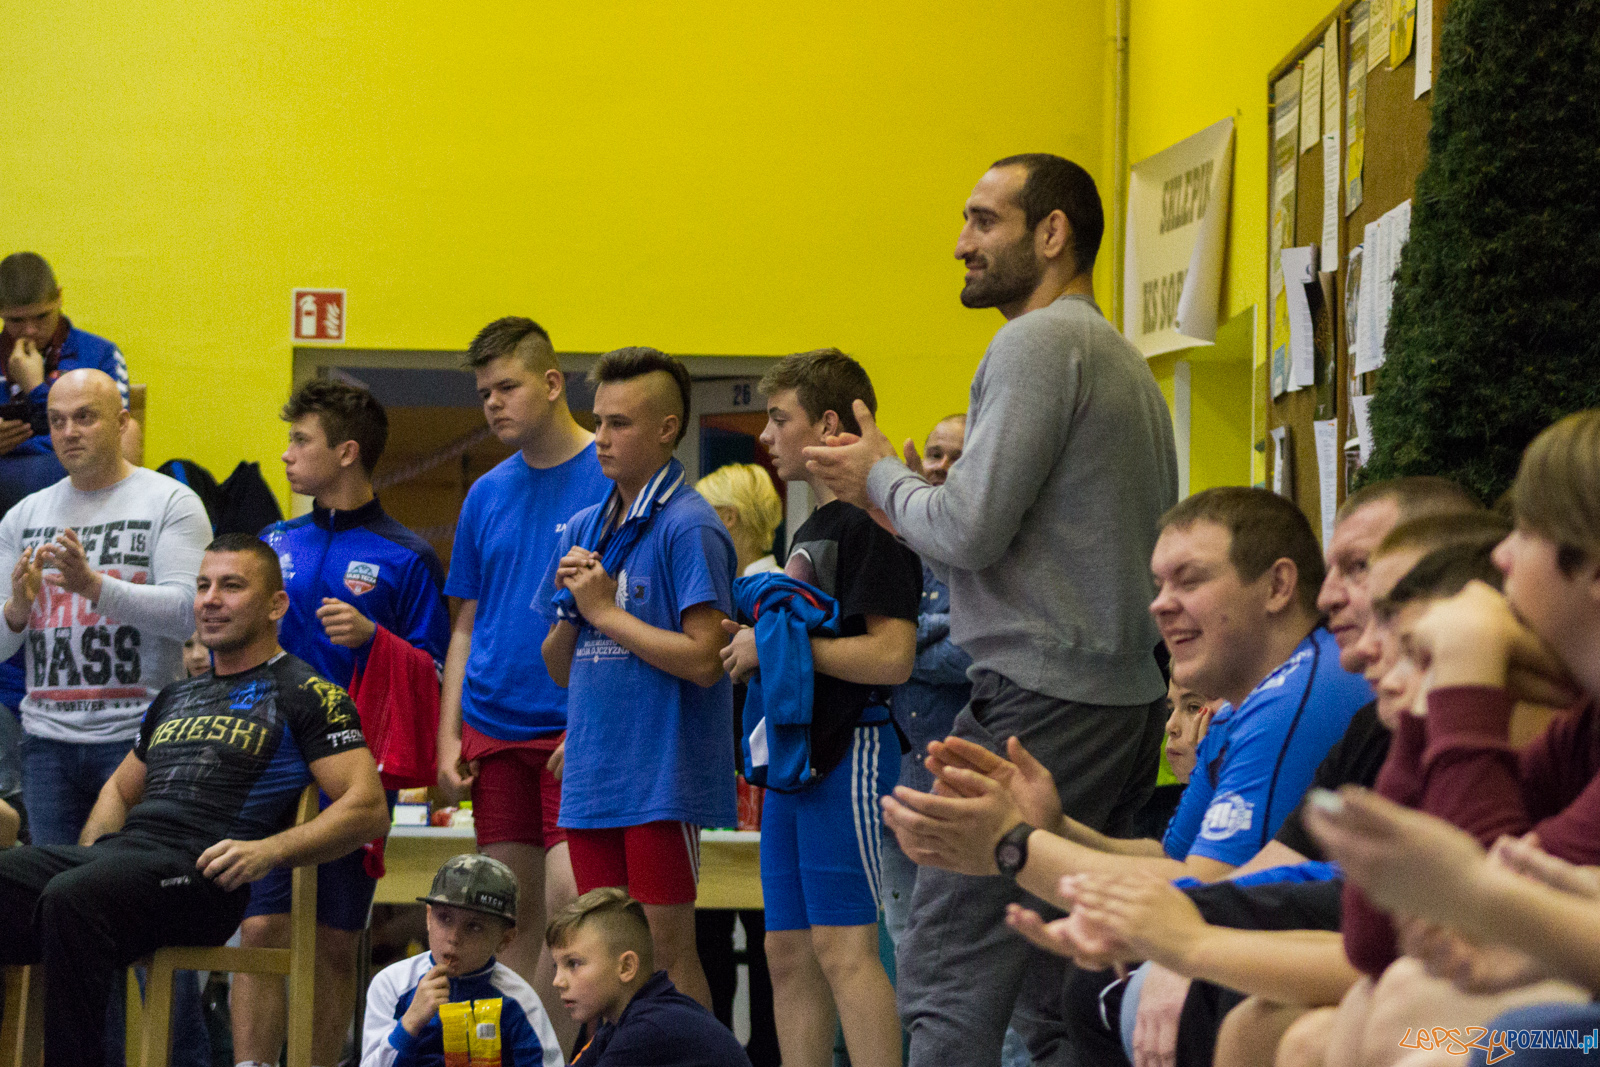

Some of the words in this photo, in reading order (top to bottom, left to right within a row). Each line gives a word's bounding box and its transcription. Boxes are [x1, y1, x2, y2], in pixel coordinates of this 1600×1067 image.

[130, 532, 146, 553] IS
[29, 625, 141, 687] BASS
[56, 700, 106, 712] FOREVER
